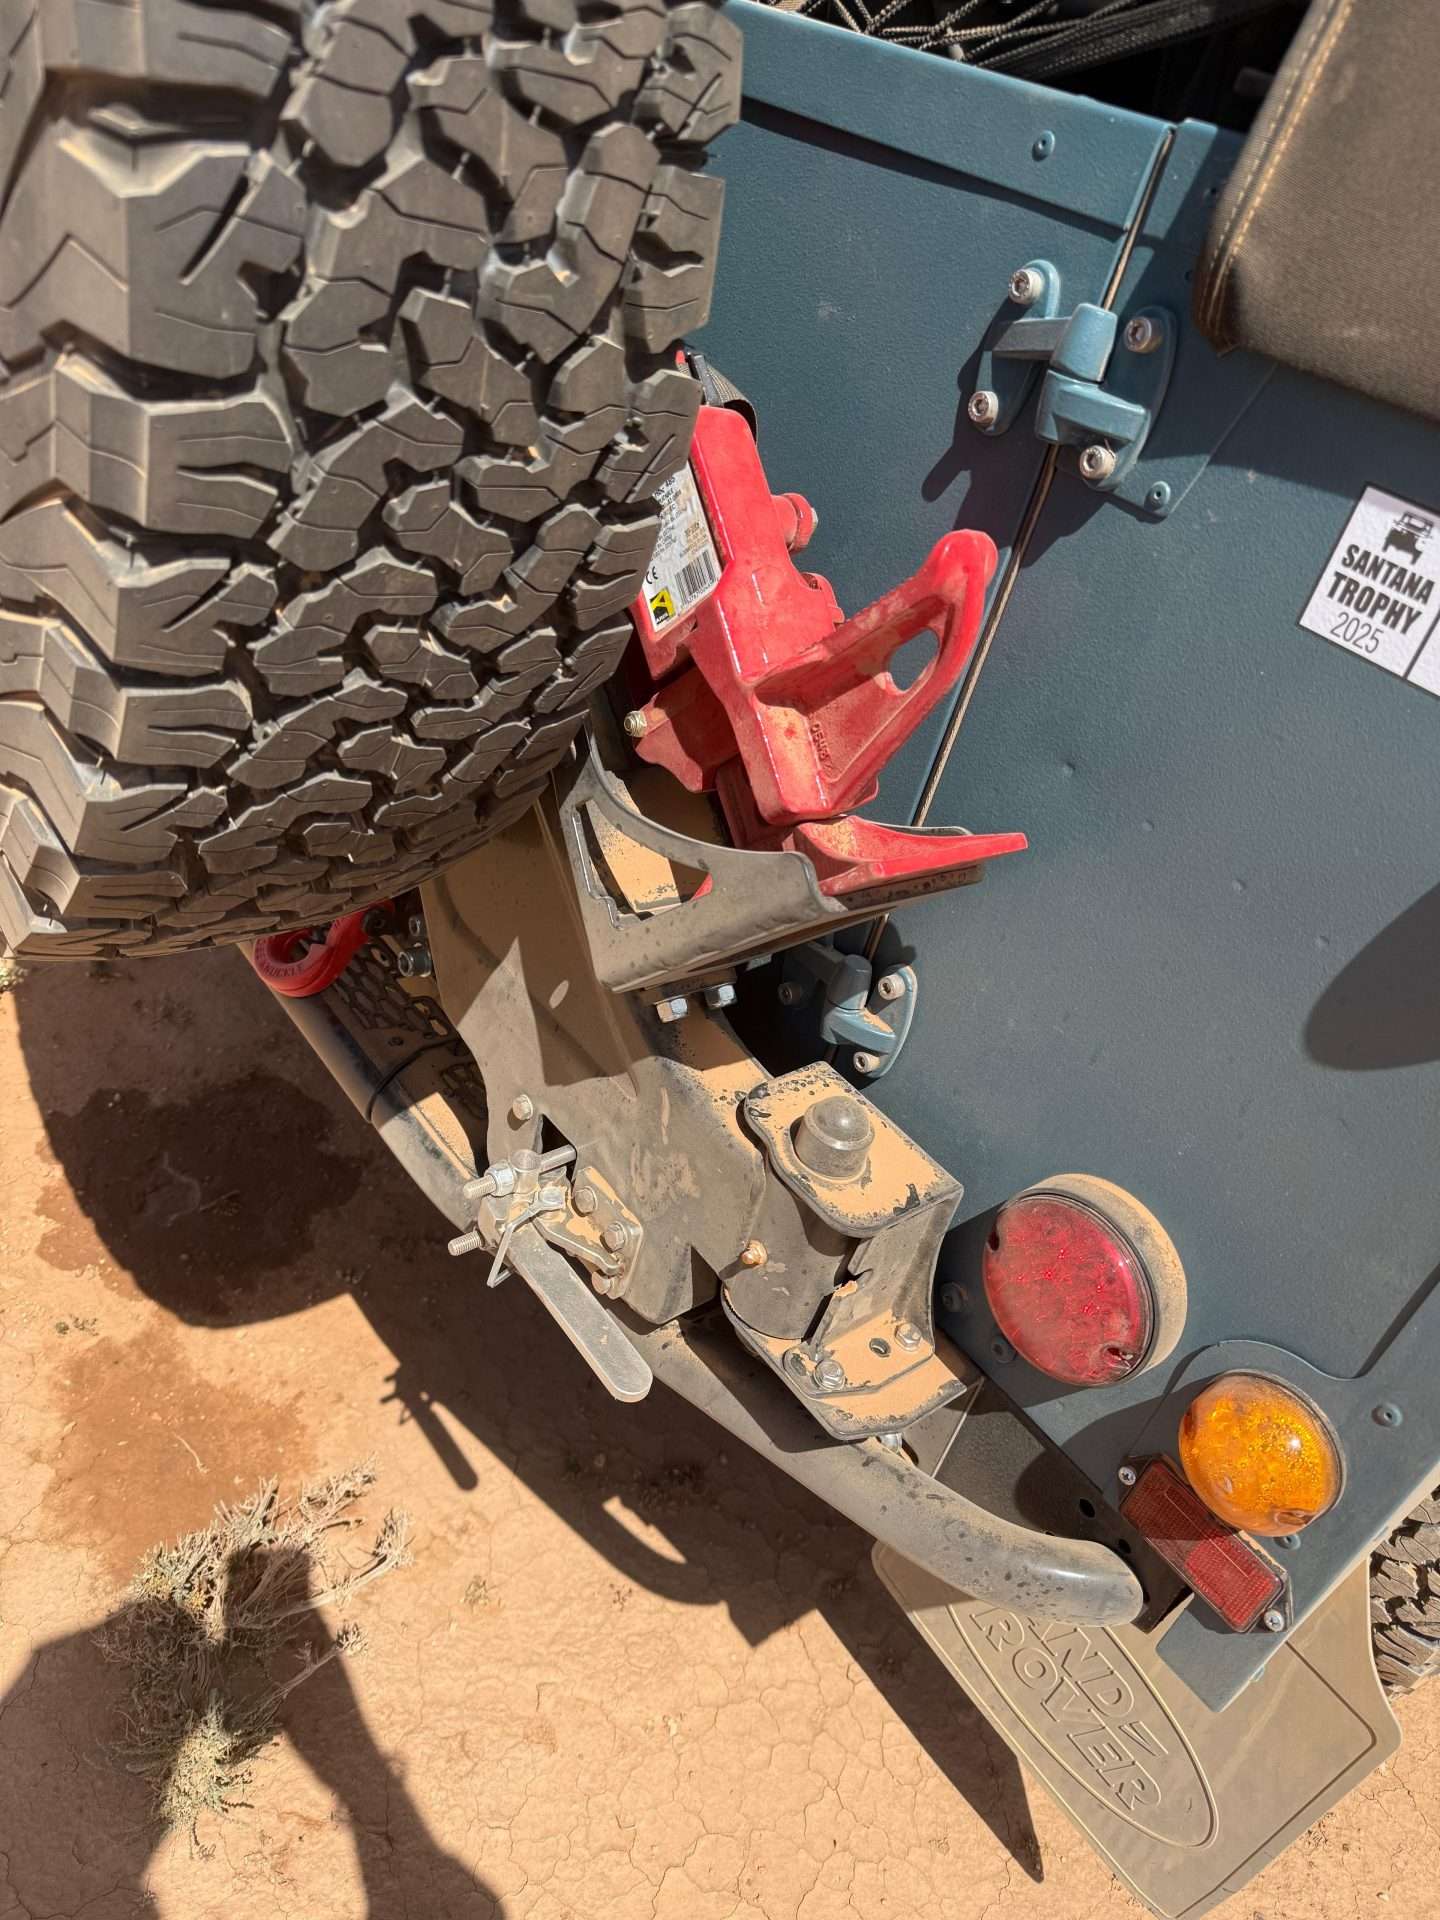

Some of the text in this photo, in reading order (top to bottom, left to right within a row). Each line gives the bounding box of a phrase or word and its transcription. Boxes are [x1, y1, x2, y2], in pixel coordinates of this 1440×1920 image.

[1327, 571, 1423, 635] TROPHY
[1342, 544, 1435, 605] SANTANA
[1330, 611, 1385, 654] 2025
[969, 1607, 1163, 1811] ROVER
